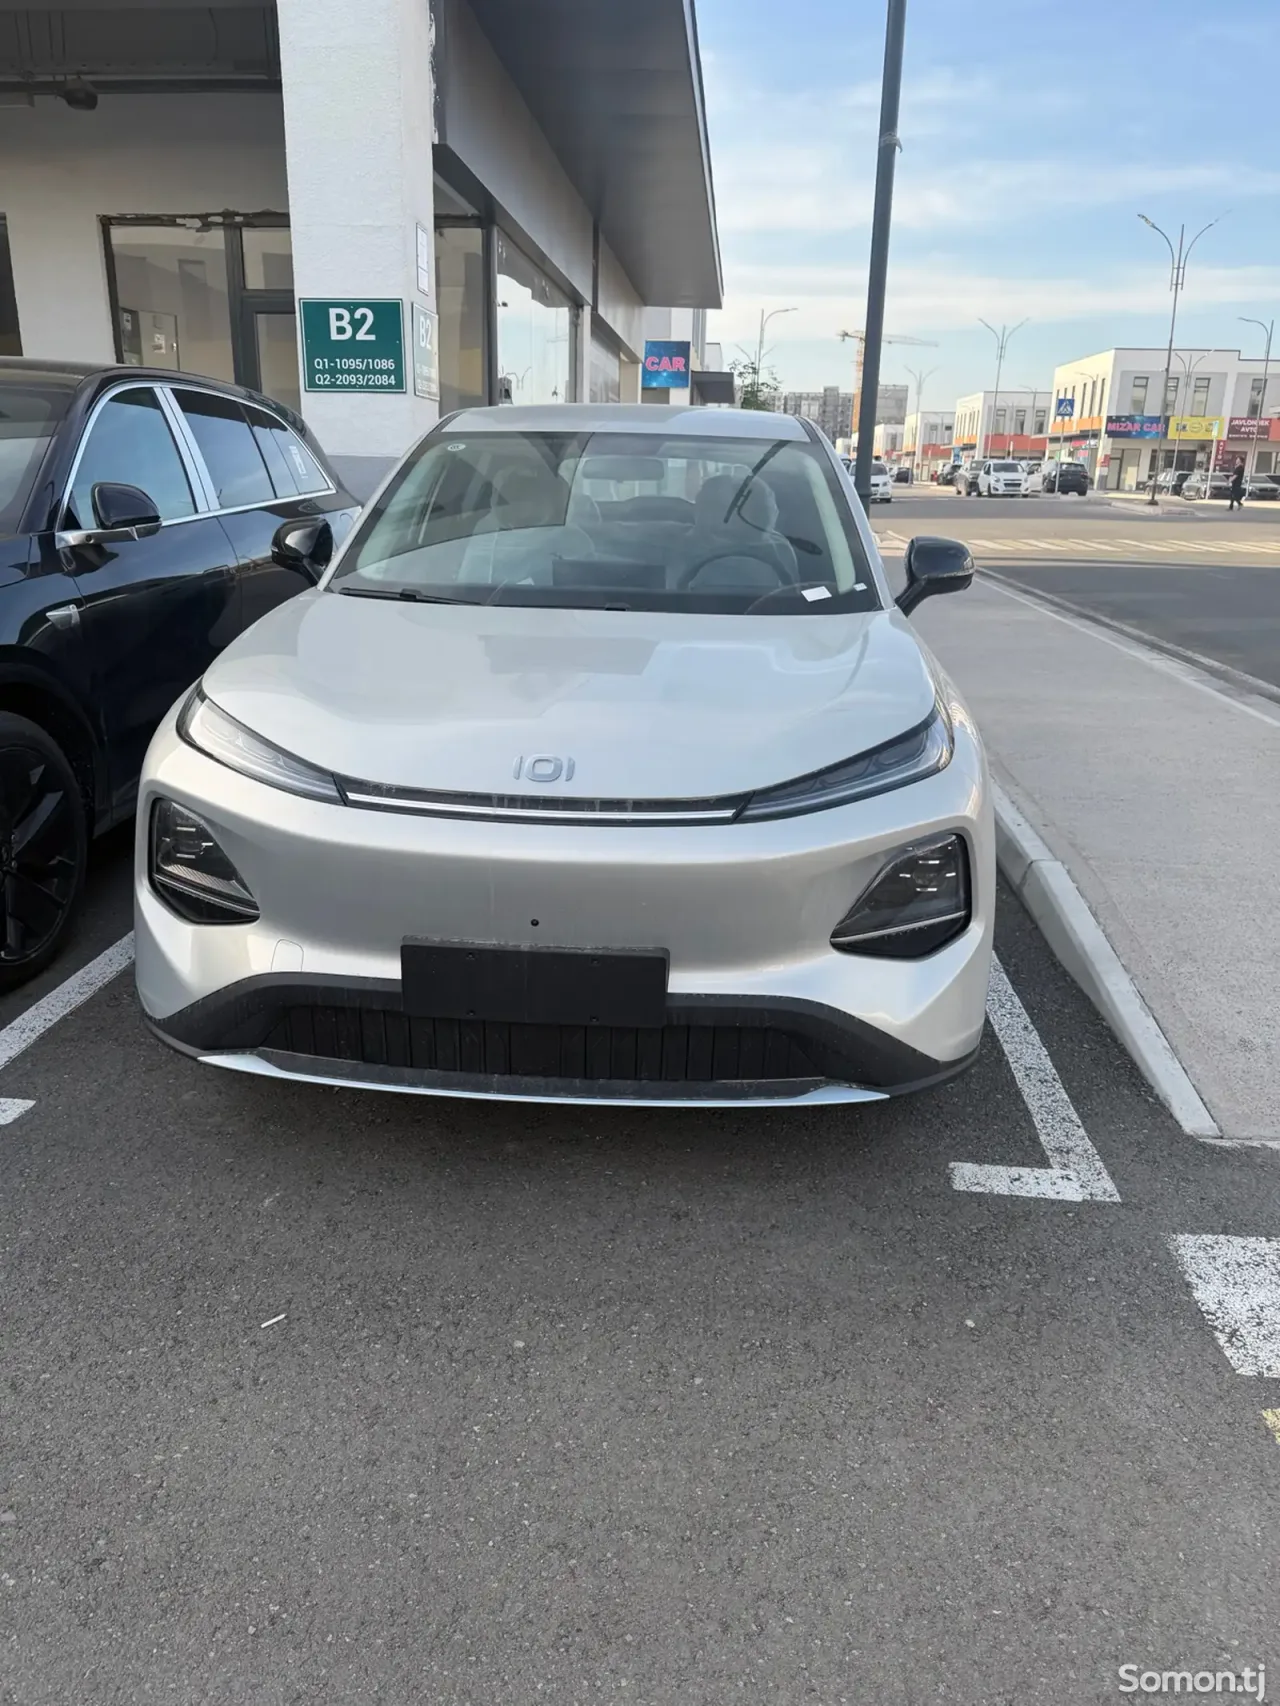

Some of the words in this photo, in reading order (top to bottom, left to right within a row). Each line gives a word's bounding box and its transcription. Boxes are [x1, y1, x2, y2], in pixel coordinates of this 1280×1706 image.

[328, 307, 376, 341] B2
[419, 315, 432, 351] B2
[314, 358, 396, 371] Q1-1095/1086
[645, 356, 686, 372] CAR
[315, 373, 396, 386] Q2-2093/2084
[1107, 421, 1141, 432] MIZAR
